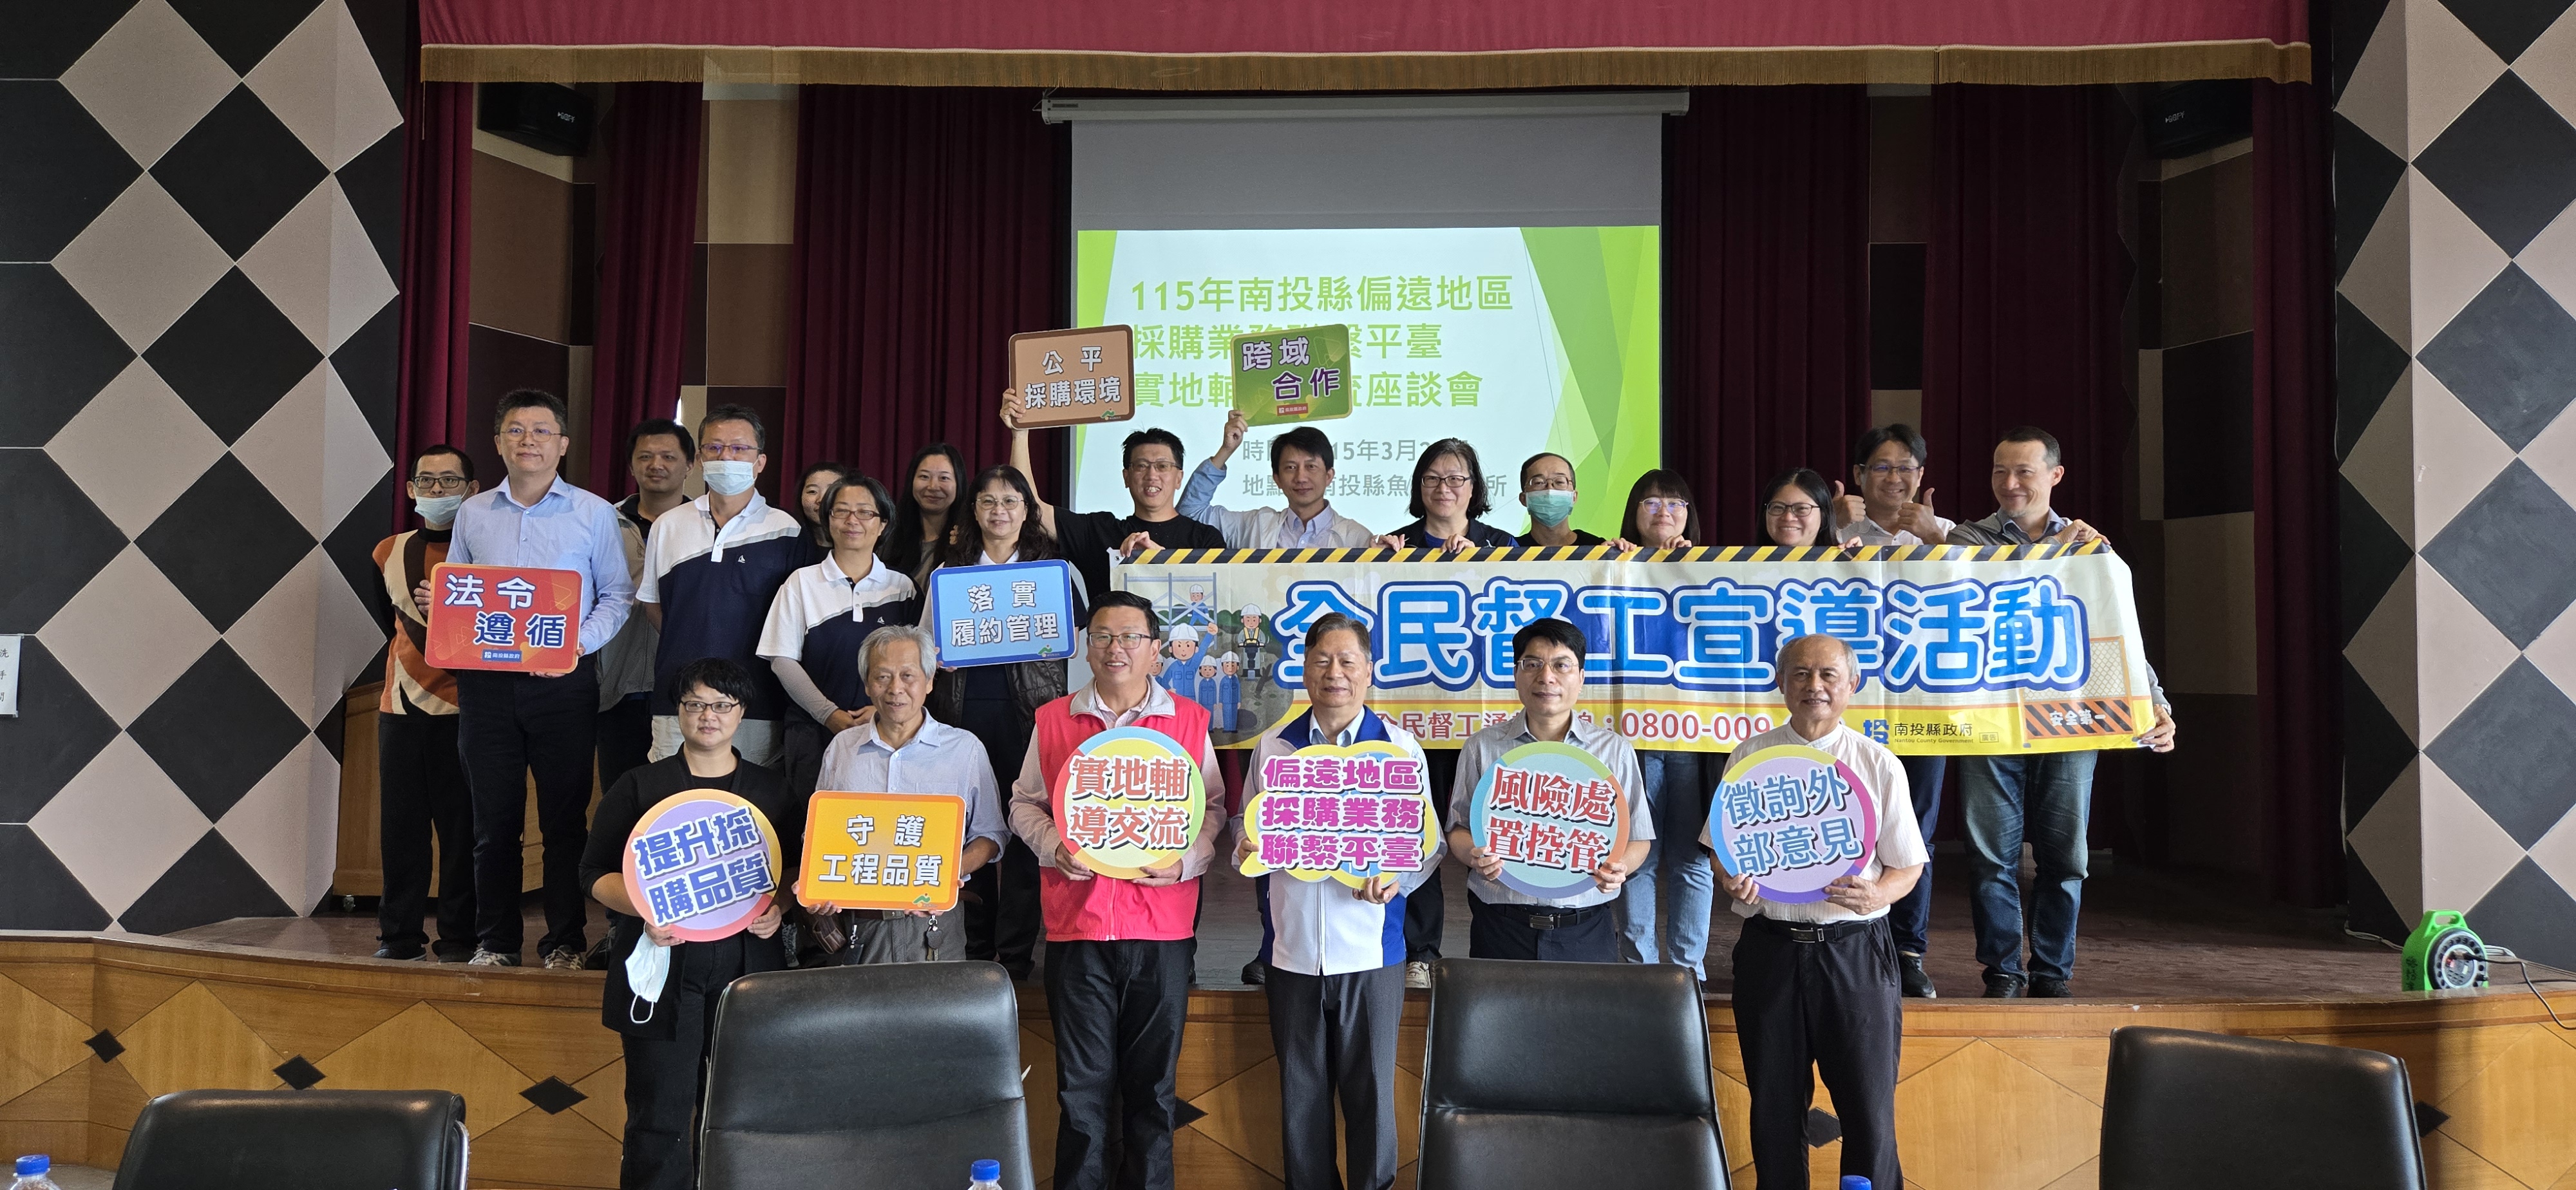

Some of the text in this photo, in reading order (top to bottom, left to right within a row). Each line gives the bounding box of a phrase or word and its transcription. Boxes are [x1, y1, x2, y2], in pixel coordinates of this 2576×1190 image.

[1132, 275, 1514, 312] 115年南投縣偏遠地區
[1134, 322, 1443, 360] 採購業平臺
[1242, 336, 1310, 372] 跨域
[1041, 346, 1103, 375] 公平
[1025, 377, 1121, 410] 採購環境
[1135, 371, 1483, 408] 實地輔座談會
[1272, 368, 1341, 401] 合作
[444, 573, 536, 610] 法令
[967, 580, 1036, 612] 落實
[473, 611, 566, 648] 遵循
[951, 613, 1059, 647] 履約管理
[1274, 578, 2087, 689] 全民督工宣導活動
[1894, 722, 1973, 737] 南投縣政府
[2049, 709, 2107, 727] 安全第一
[1072, 757, 1188, 798] 實地輔
[1262, 757, 1421, 790] 偏遠地區
[1262, 796, 1422, 829] 採購業務
[1490, 768, 1615, 822] 風險處
[1722, 767, 1850, 824] 徵詢外
[633, 808, 759, 878] 提升採
[846, 815, 925, 847] 守護
[1069, 805, 1188, 846] 導交流
[1260, 835, 1422, 869] 聯繫平臺
[1486, 818, 1608, 873] 置控管
[1735, 820, 1862, 874] 部意見
[818, 853, 943, 887] 工程品質
[649, 853, 775, 925] 購品質
